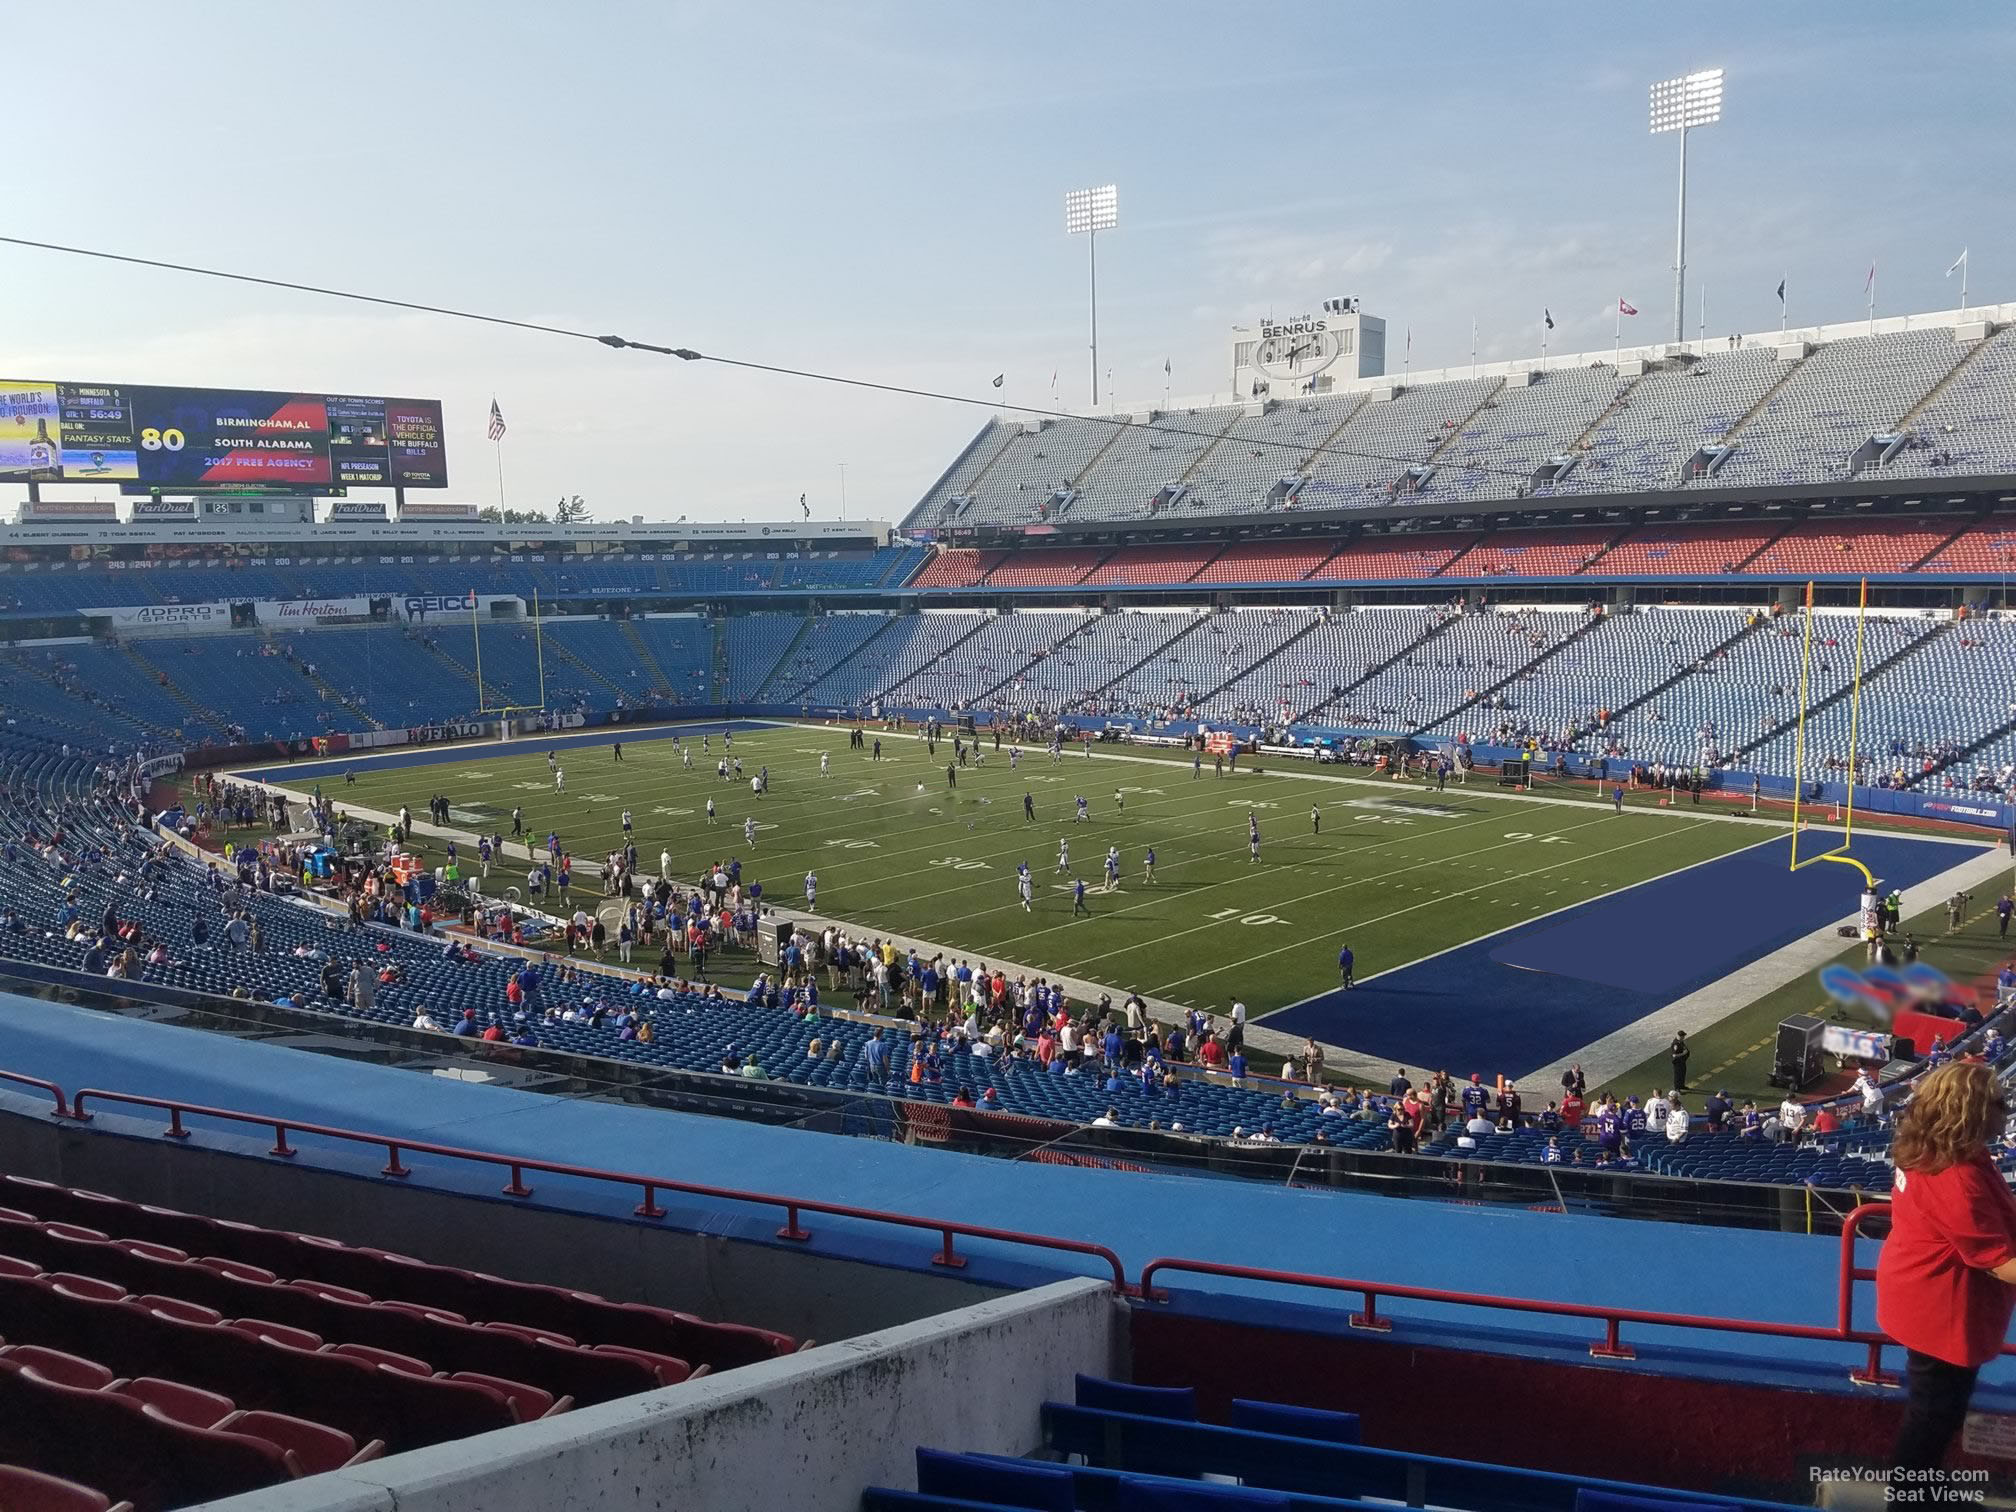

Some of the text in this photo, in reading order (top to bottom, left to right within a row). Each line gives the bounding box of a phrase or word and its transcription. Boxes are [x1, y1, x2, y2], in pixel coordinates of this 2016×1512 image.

[1263, 321, 1327, 338] BENRUS
[1315, 345, 1321, 356] 3
[1266, 352, 1273, 363] 9
[79, 388, 111, 397] MINNESOTA
[9, 392, 42, 405] WORLD'S
[90, 409, 122, 420] 56:49
[397, 415, 432, 424] TOYOTA IS
[60, 422, 85, 430] BALL ON:
[392, 423, 438, 432] THE OFFICIAL
[64, 434, 132, 443] FANTASY STATS
[141, 428, 185, 451] 80
[214, 438, 313, 449] SOUTH ALABAMA
[407, 440, 438, 448] BUFFALO
[406, 448, 426, 456] BILLS
[204, 457, 314, 468] 2017 FREE AGENCY
[341, 462, 379, 470] NFL PRESEASON
[359, 473, 382, 481] MATCHUP
[136, 502, 190, 513] FanDuel
[337, 503, 383, 514] FanDuel
[108, 561, 126, 569] 243
[135, 561, 152, 569] 244
[380, 556, 394, 564] 200
[277, 601, 348, 617] Tim Hortons
[404, 596, 479, 612] GEICO
[142, 614, 212, 623] SPORTS
[928, 856, 987, 871] 30
[1203, 907, 1280, 927] 10
[1469, 1096, 1482, 1105] 32
[1506, 1097, 1513, 1107] 5
[1654, 1107, 1667, 1120] 13
[1785, 1107, 1795, 1118] 13
[1604, 1123, 1615, 1134] 14
[1631, 1119, 1645, 1130] 25
[1547, 1152, 1561, 1163] 28
